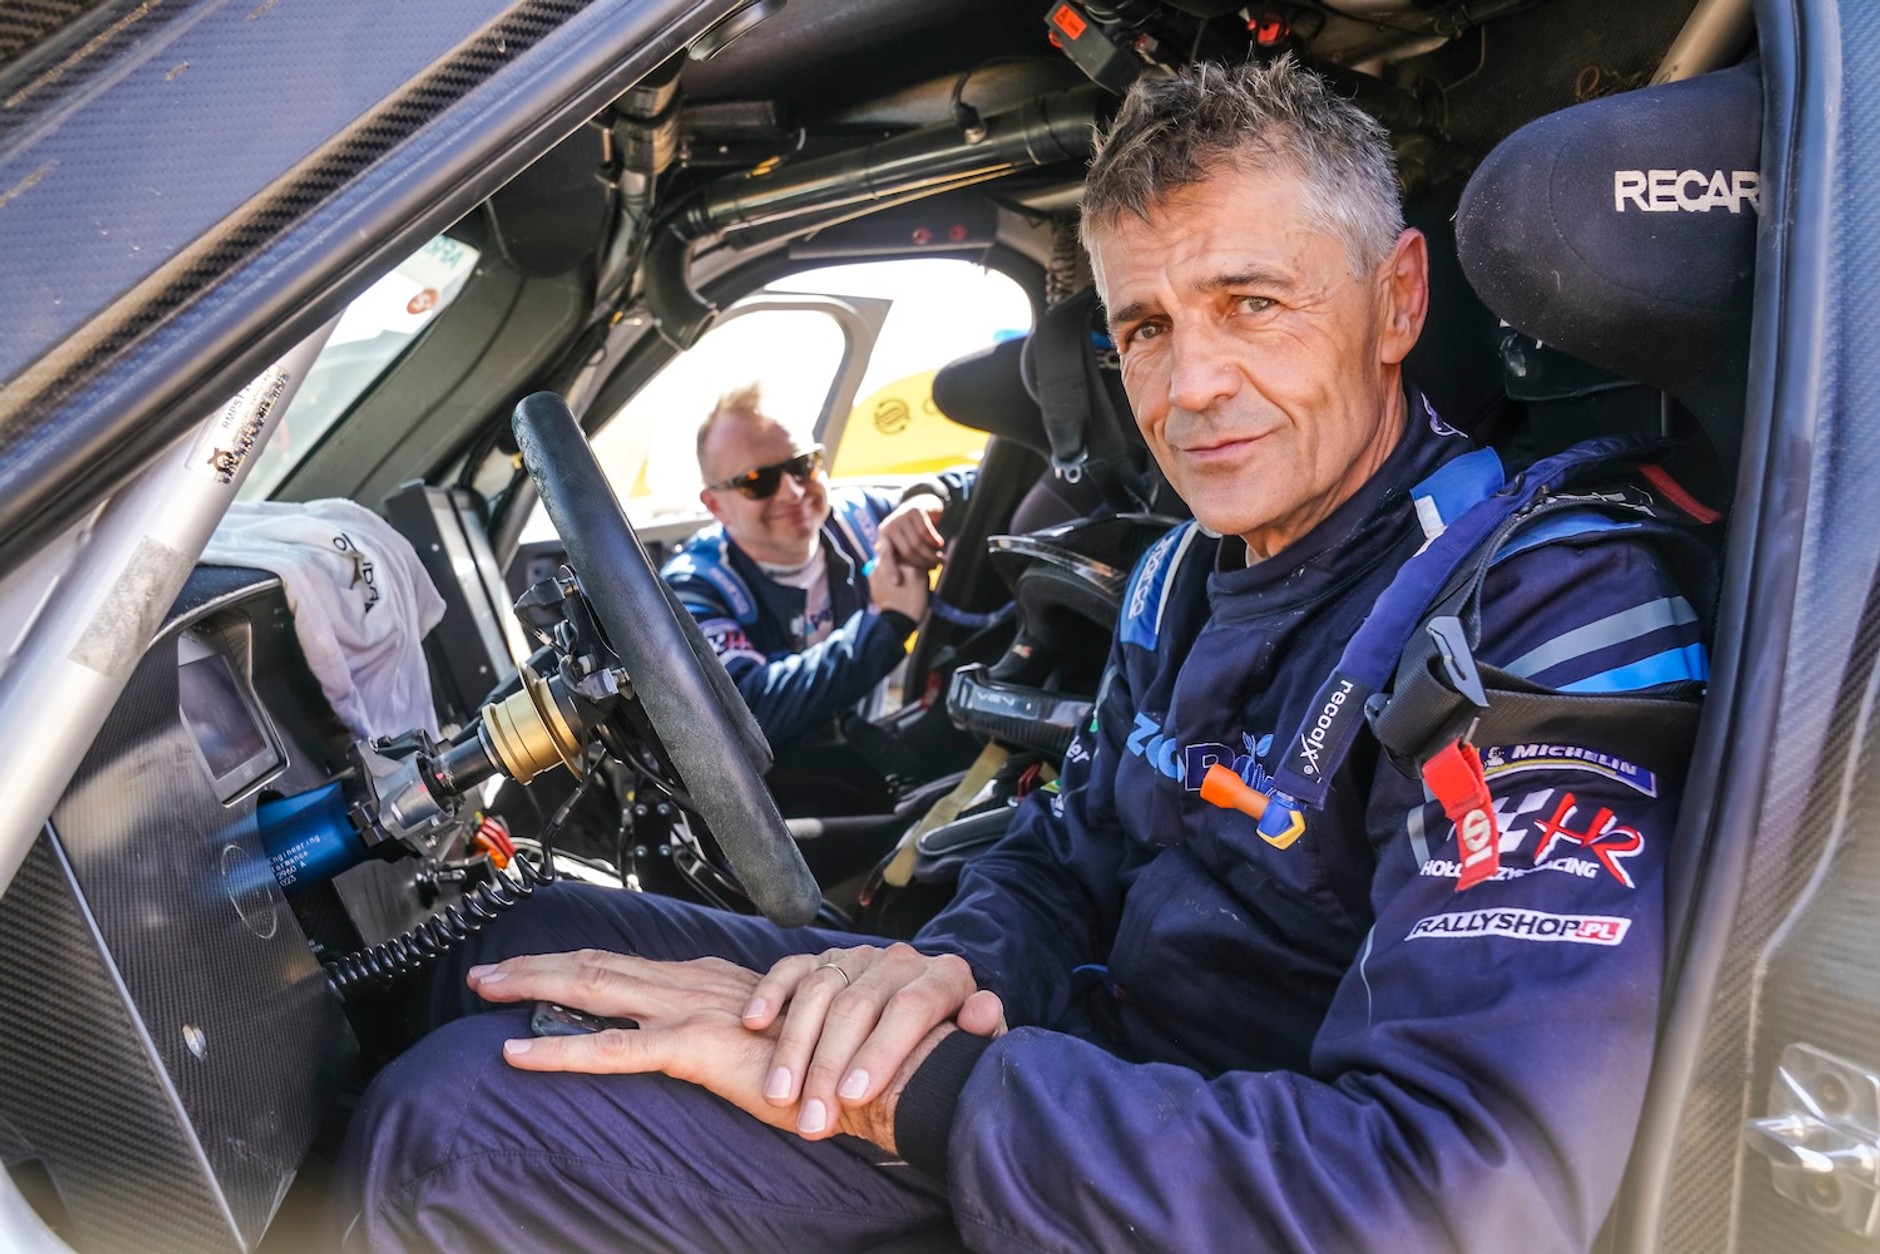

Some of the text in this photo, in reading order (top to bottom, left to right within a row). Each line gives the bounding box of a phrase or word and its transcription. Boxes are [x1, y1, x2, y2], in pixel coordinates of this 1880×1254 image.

[1615, 169, 1760, 213] RECAR
[1511, 745, 1638, 775] MICHELIN
[1534, 793, 1645, 889] HR
[1413, 913, 1620, 940] RALLYSHOP.PL
